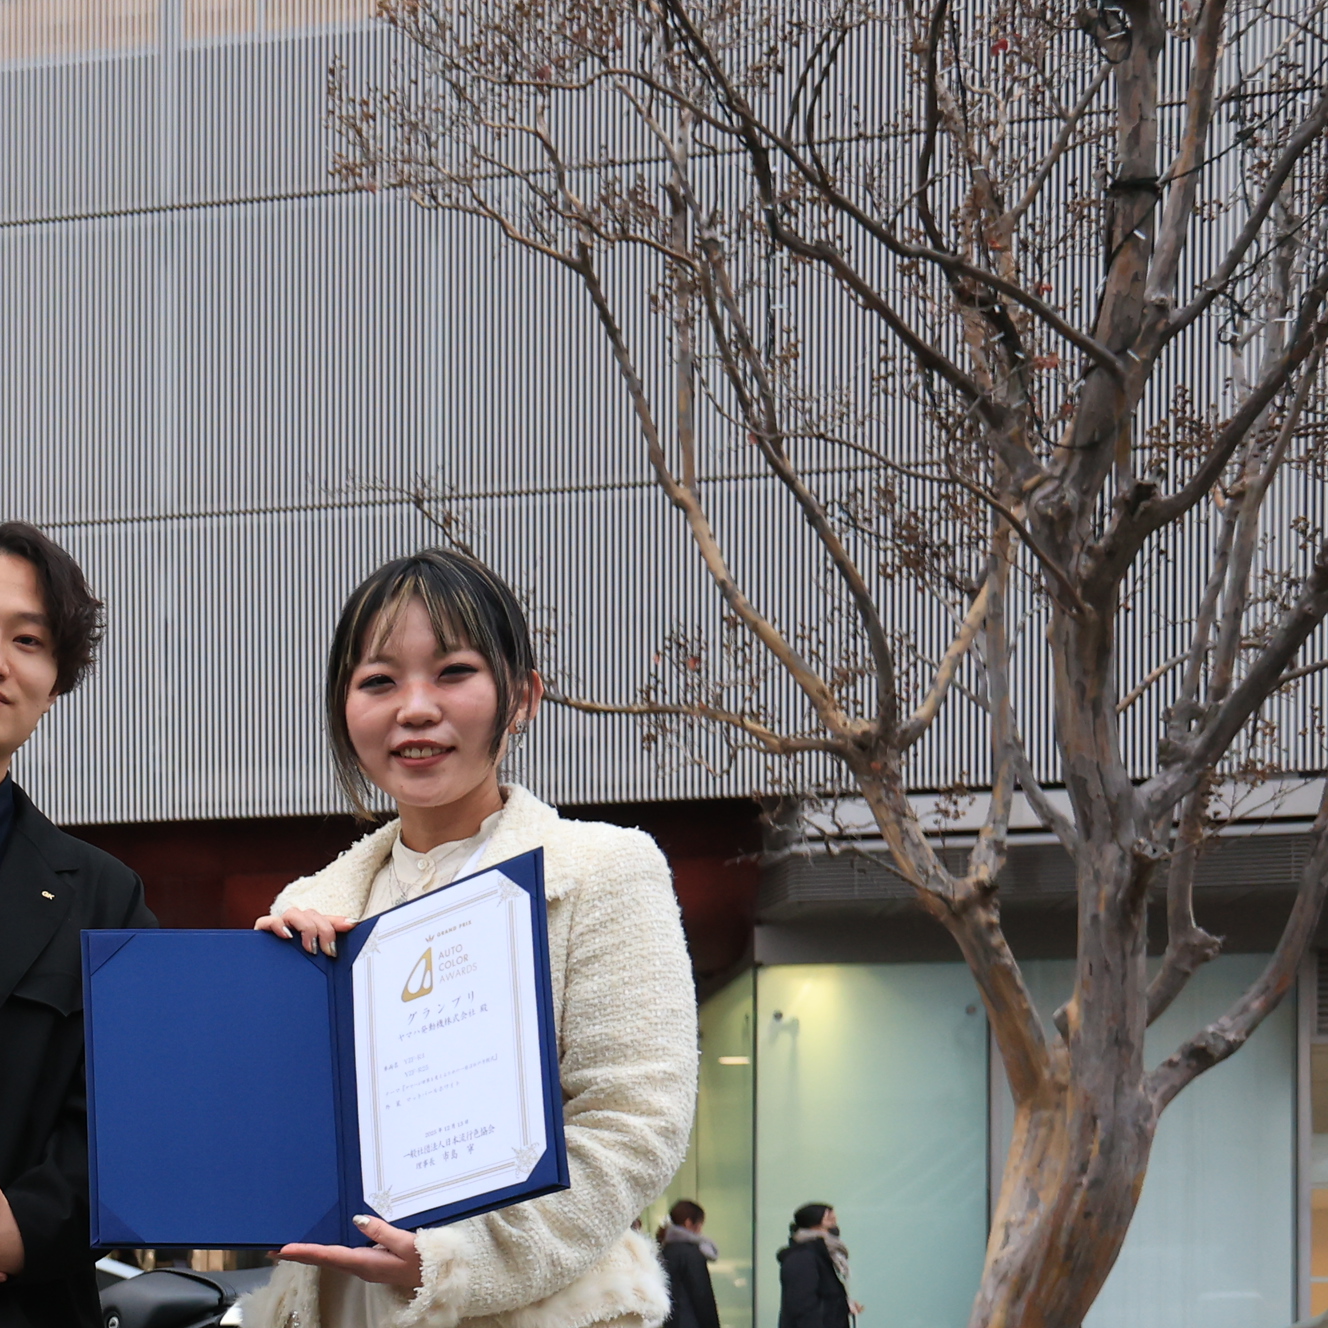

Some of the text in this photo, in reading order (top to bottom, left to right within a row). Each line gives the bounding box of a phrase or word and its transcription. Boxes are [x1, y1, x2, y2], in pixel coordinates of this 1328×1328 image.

[436, 919, 472, 937] GRAND PRIX
[438, 944, 463, 960] AUTO
[438, 954, 469, 971] COLOR
[439, 962, 478, 983] AWARDS
